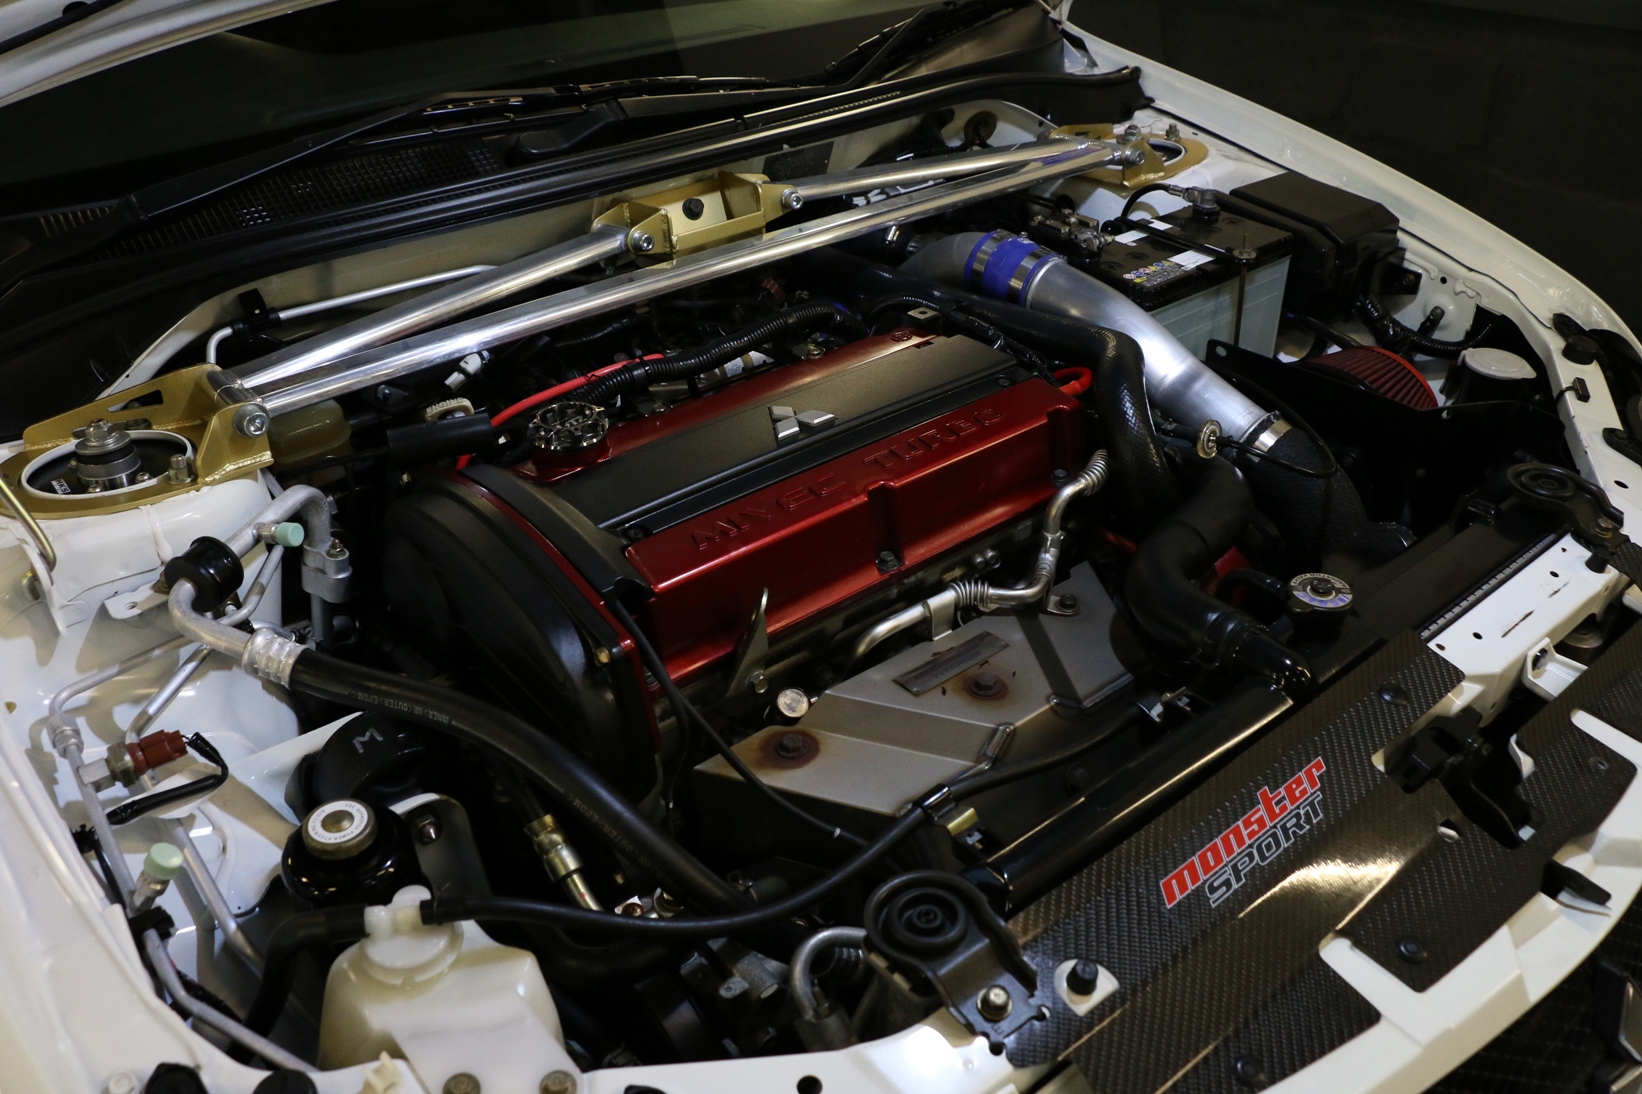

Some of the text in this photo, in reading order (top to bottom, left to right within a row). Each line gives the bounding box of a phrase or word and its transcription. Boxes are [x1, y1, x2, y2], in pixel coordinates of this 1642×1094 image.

[692, 408, 1005, 550] MIVEC TURBO
[1160, 757, 1326, 909] monster
[1205, 791, 1323, 908] SPORT
